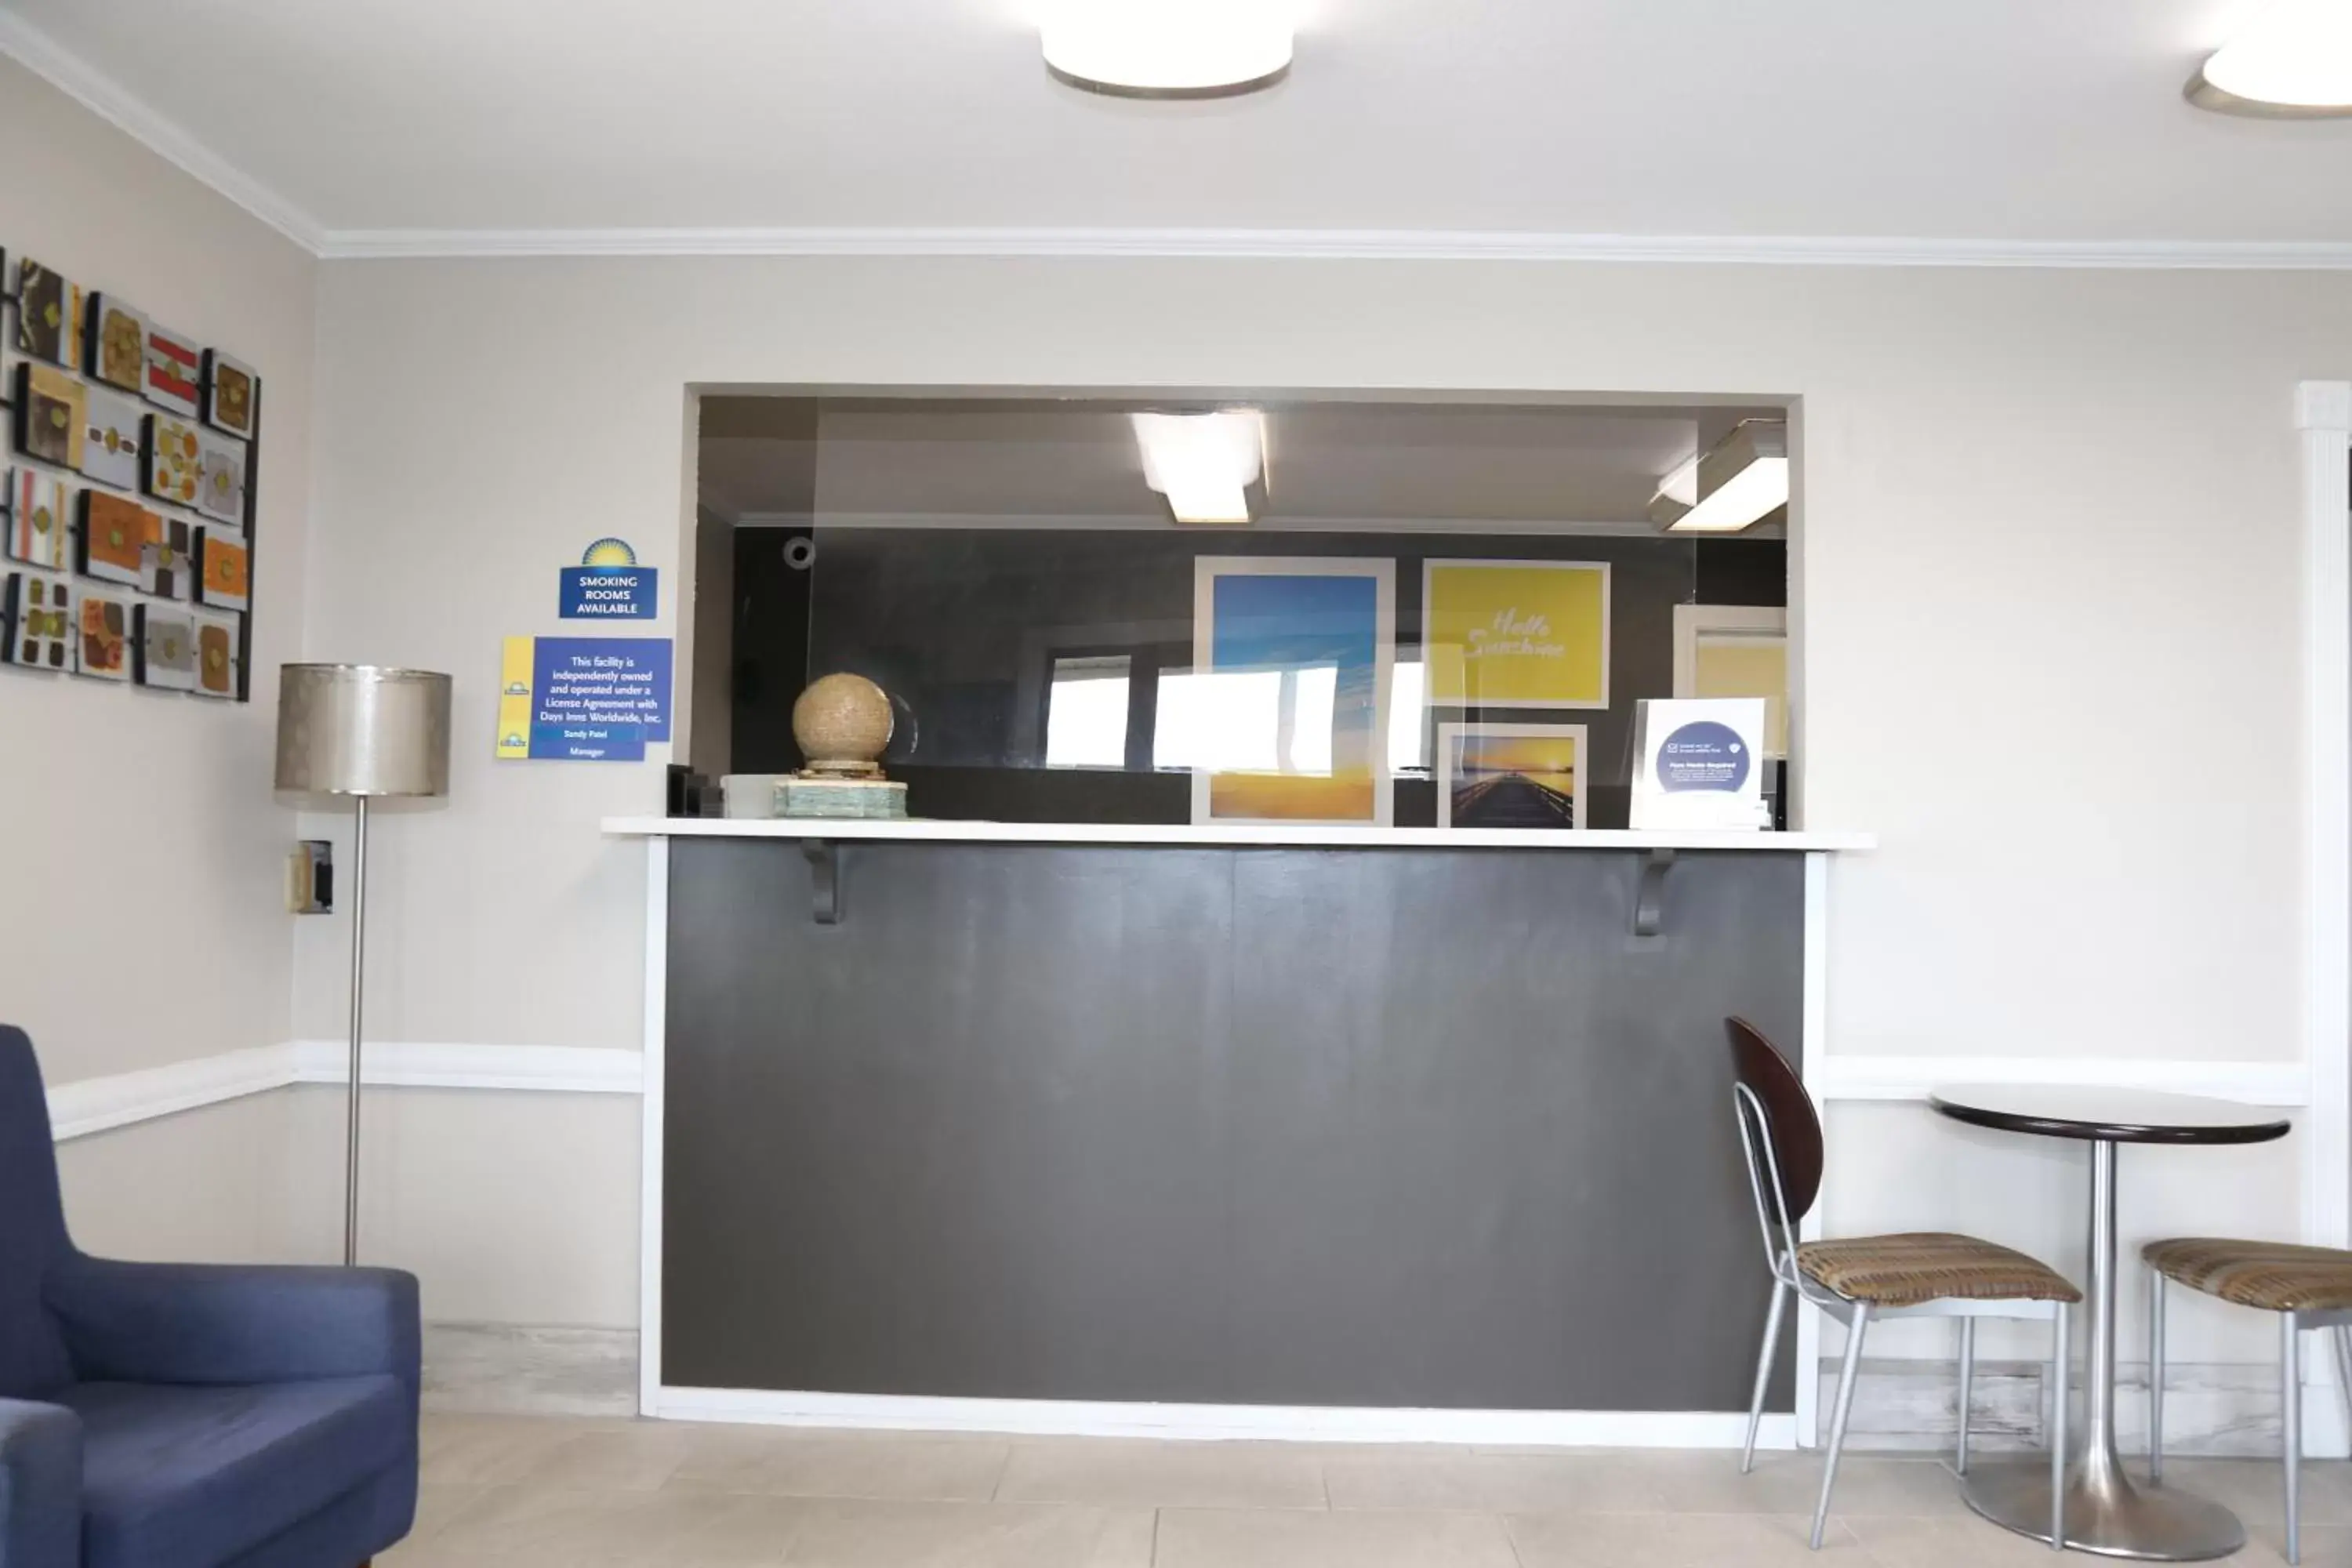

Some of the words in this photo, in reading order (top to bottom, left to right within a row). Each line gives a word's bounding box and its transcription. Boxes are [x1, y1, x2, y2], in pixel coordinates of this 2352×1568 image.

[579, 576, 638, 587] SMOKING
[586, 590, 631, 600] ROOMS
[577, 604, 637, 614] AVAILABLE
[1493, 606, 1552, 637] Hello
[1464, 628, 1566, 659] Sunshine
[571, 656, 592, 666] This
[593, 656, 624, 670] facility
[626, 657, 634, 667] is
[553, 670, 619, 683] independently
[620, 671, 653, 681] owned
[550, 684, 568, 694] and
[571, 684, 612, 696] operated
[615, 685, 642, 695] under
[545, 698, 581, 708] License
[583, 699, 634, 711] Agreement
[637, 699, 658, 709] with
[539, 711, 564, 723] Days
[566, 712, 587, 721] Inns
[589, 712, 642, 724] Worldwide,
[644, 713, 662, 723] Inc.
[570, 747, 605, 758] Manager
